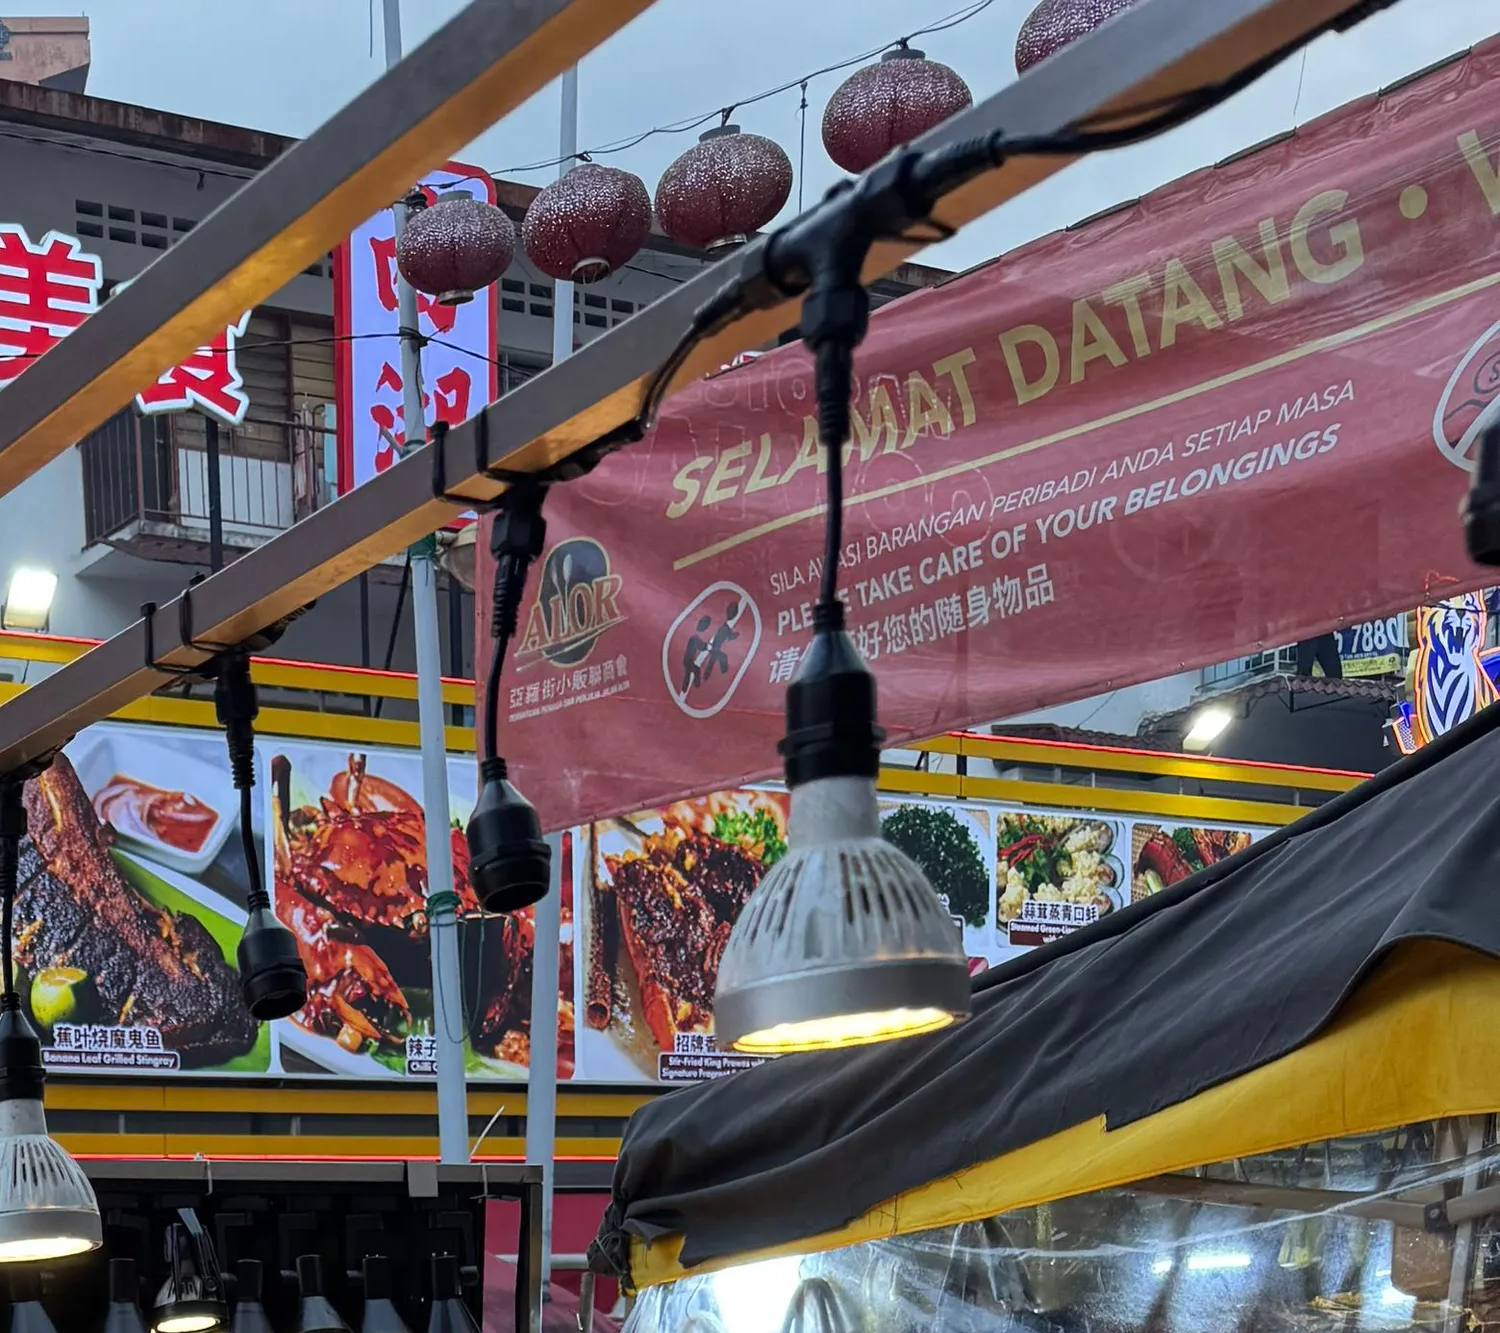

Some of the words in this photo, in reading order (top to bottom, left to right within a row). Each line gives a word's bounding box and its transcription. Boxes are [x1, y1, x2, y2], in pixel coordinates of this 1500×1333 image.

[665, 346, 977, 520] SELAMAT
[998, 189, 1366, 407] DATANG
[770, 568, 804, 596] SILA
[808, 543, 862, 579] AASI
[866, 500, 987, 560] BARANGAN
[990, 466, 1097, 517] PERIBADI
[1100, 442, 1175, 485] ANDA
[1181, 409, 1272, 457] SETIAP
[1275, 379, 1355, 427] MASA
[777, 587, 852, 636] PLEE
[856, 565, 914, 606] TAKE
[919, 539, 985, 585] CARE
[990, 523, 1028, 560] OF
[1036, 496, 1118, 544] YOUR
[1124, 422, 1342, 516] BELONGINGS
[517, 574, 624, 655] ALOR
[769, 563, 1055, 684] 请好您的随身物品
[43, 1052, 80, 1064] Banana
